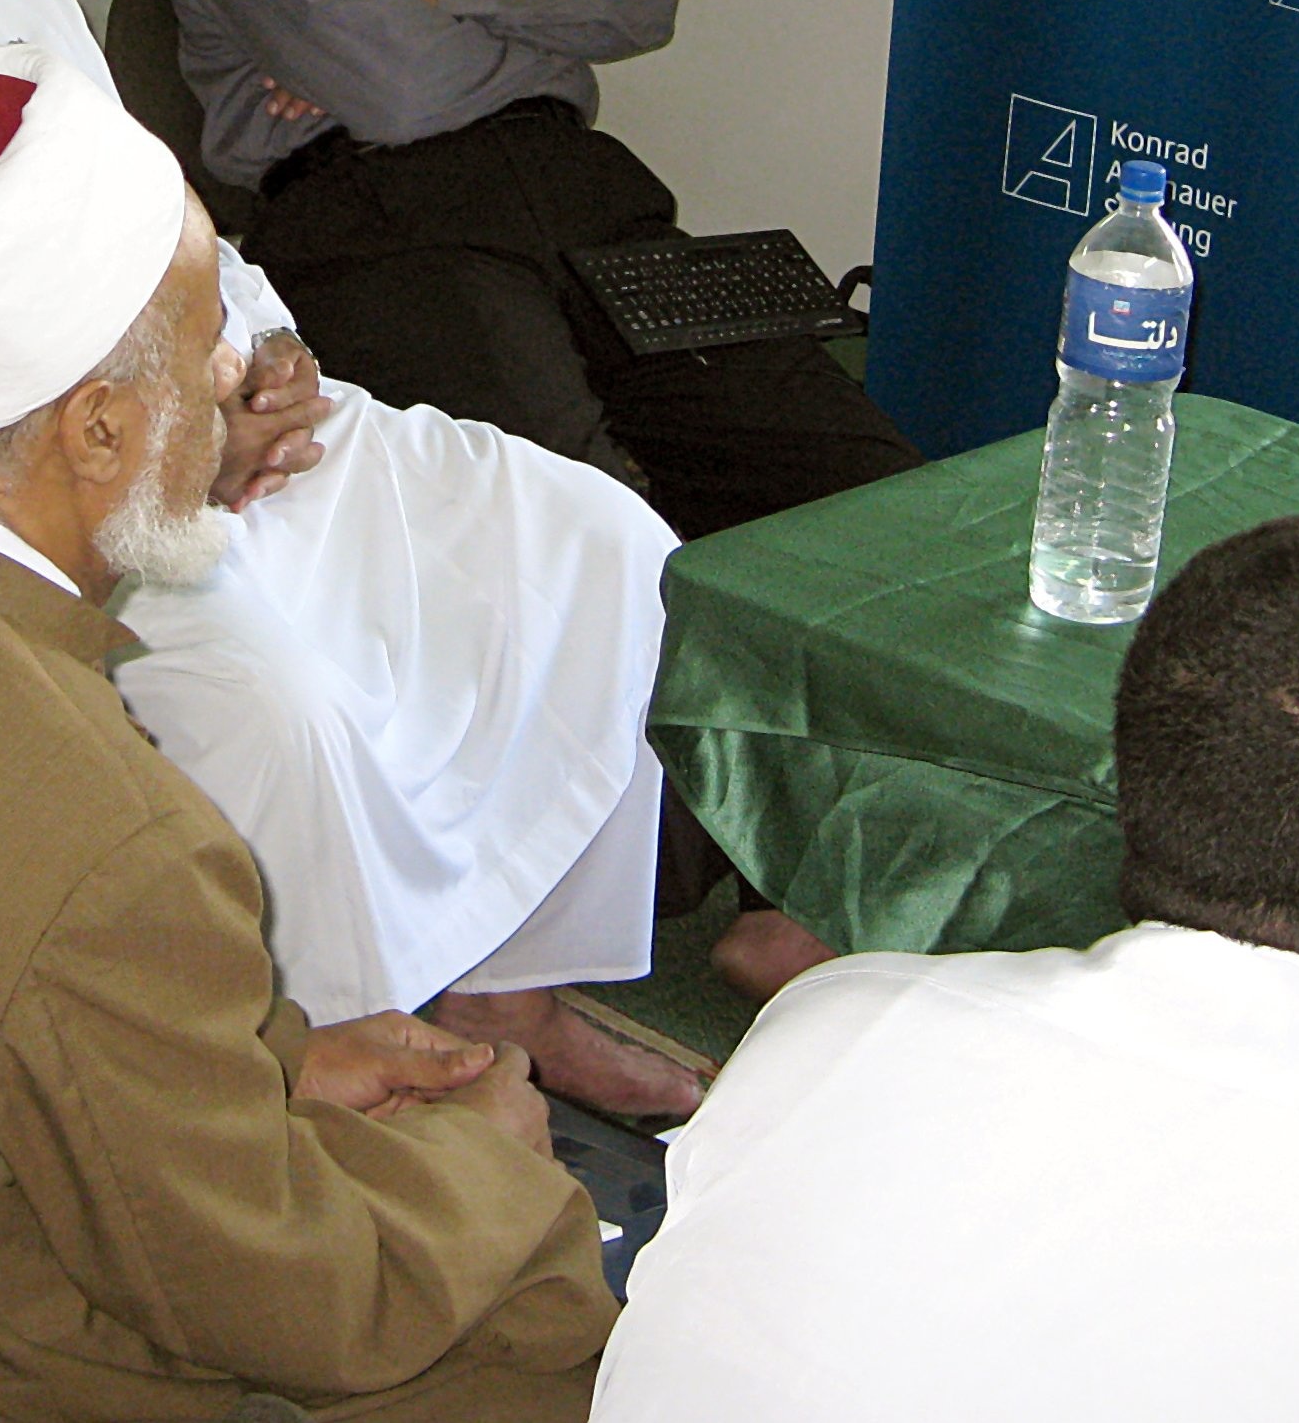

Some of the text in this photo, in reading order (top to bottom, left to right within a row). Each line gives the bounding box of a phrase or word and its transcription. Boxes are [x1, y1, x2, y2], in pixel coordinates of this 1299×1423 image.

[1110, 119, 1209, 171] Konrad
[1104, 159, 1239, 219] Anauer
[1087, 310, 1178, 351] دلتا
